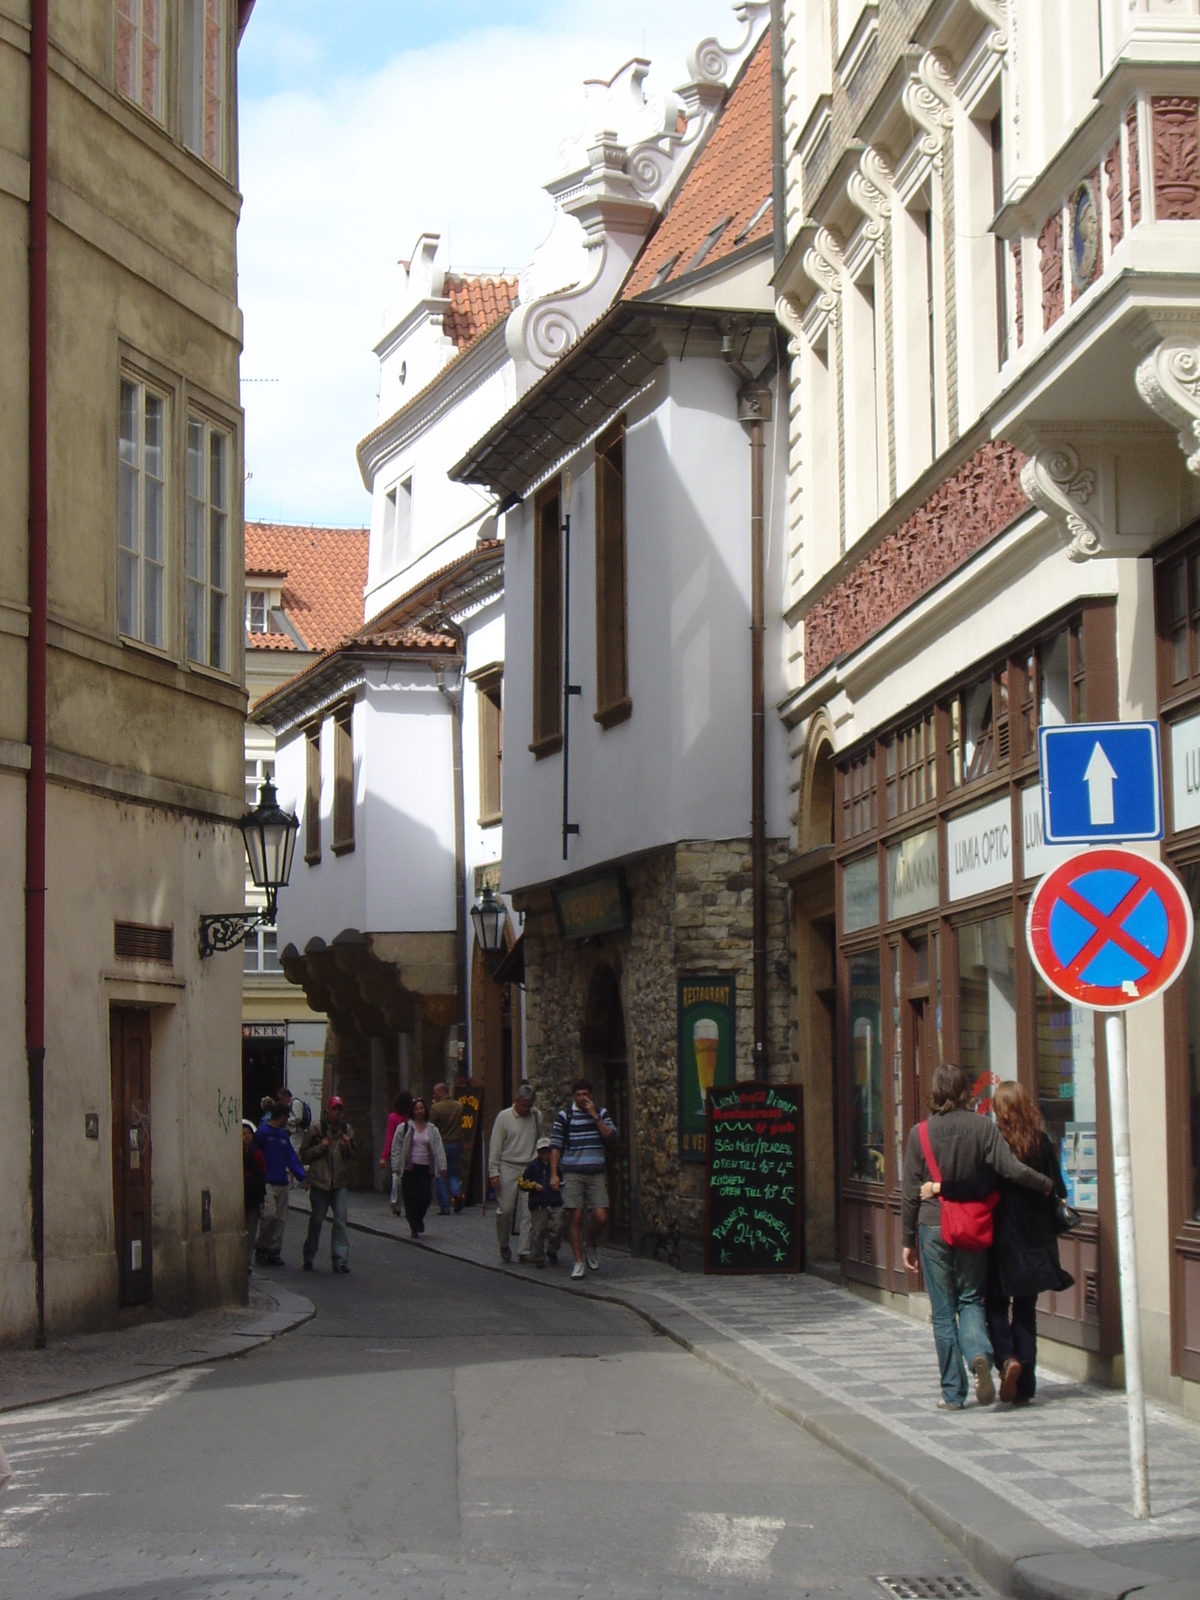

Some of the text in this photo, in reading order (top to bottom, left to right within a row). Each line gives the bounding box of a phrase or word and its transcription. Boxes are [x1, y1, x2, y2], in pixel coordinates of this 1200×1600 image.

[982, 823, 1009, 866] OPTIC
[683, 986, 729, 1008] RESTAURANT
[711, 1091, 739, 1109] Lunch
[766, 1089, 798, 1113] Dinner
[712, 1108, 783, 1120] Restaurant
[769, 1121, 795, 1136] pub
[713, 1158, 738, 1169] OPEN
[720, 1186, 741, 1197] OPEN
